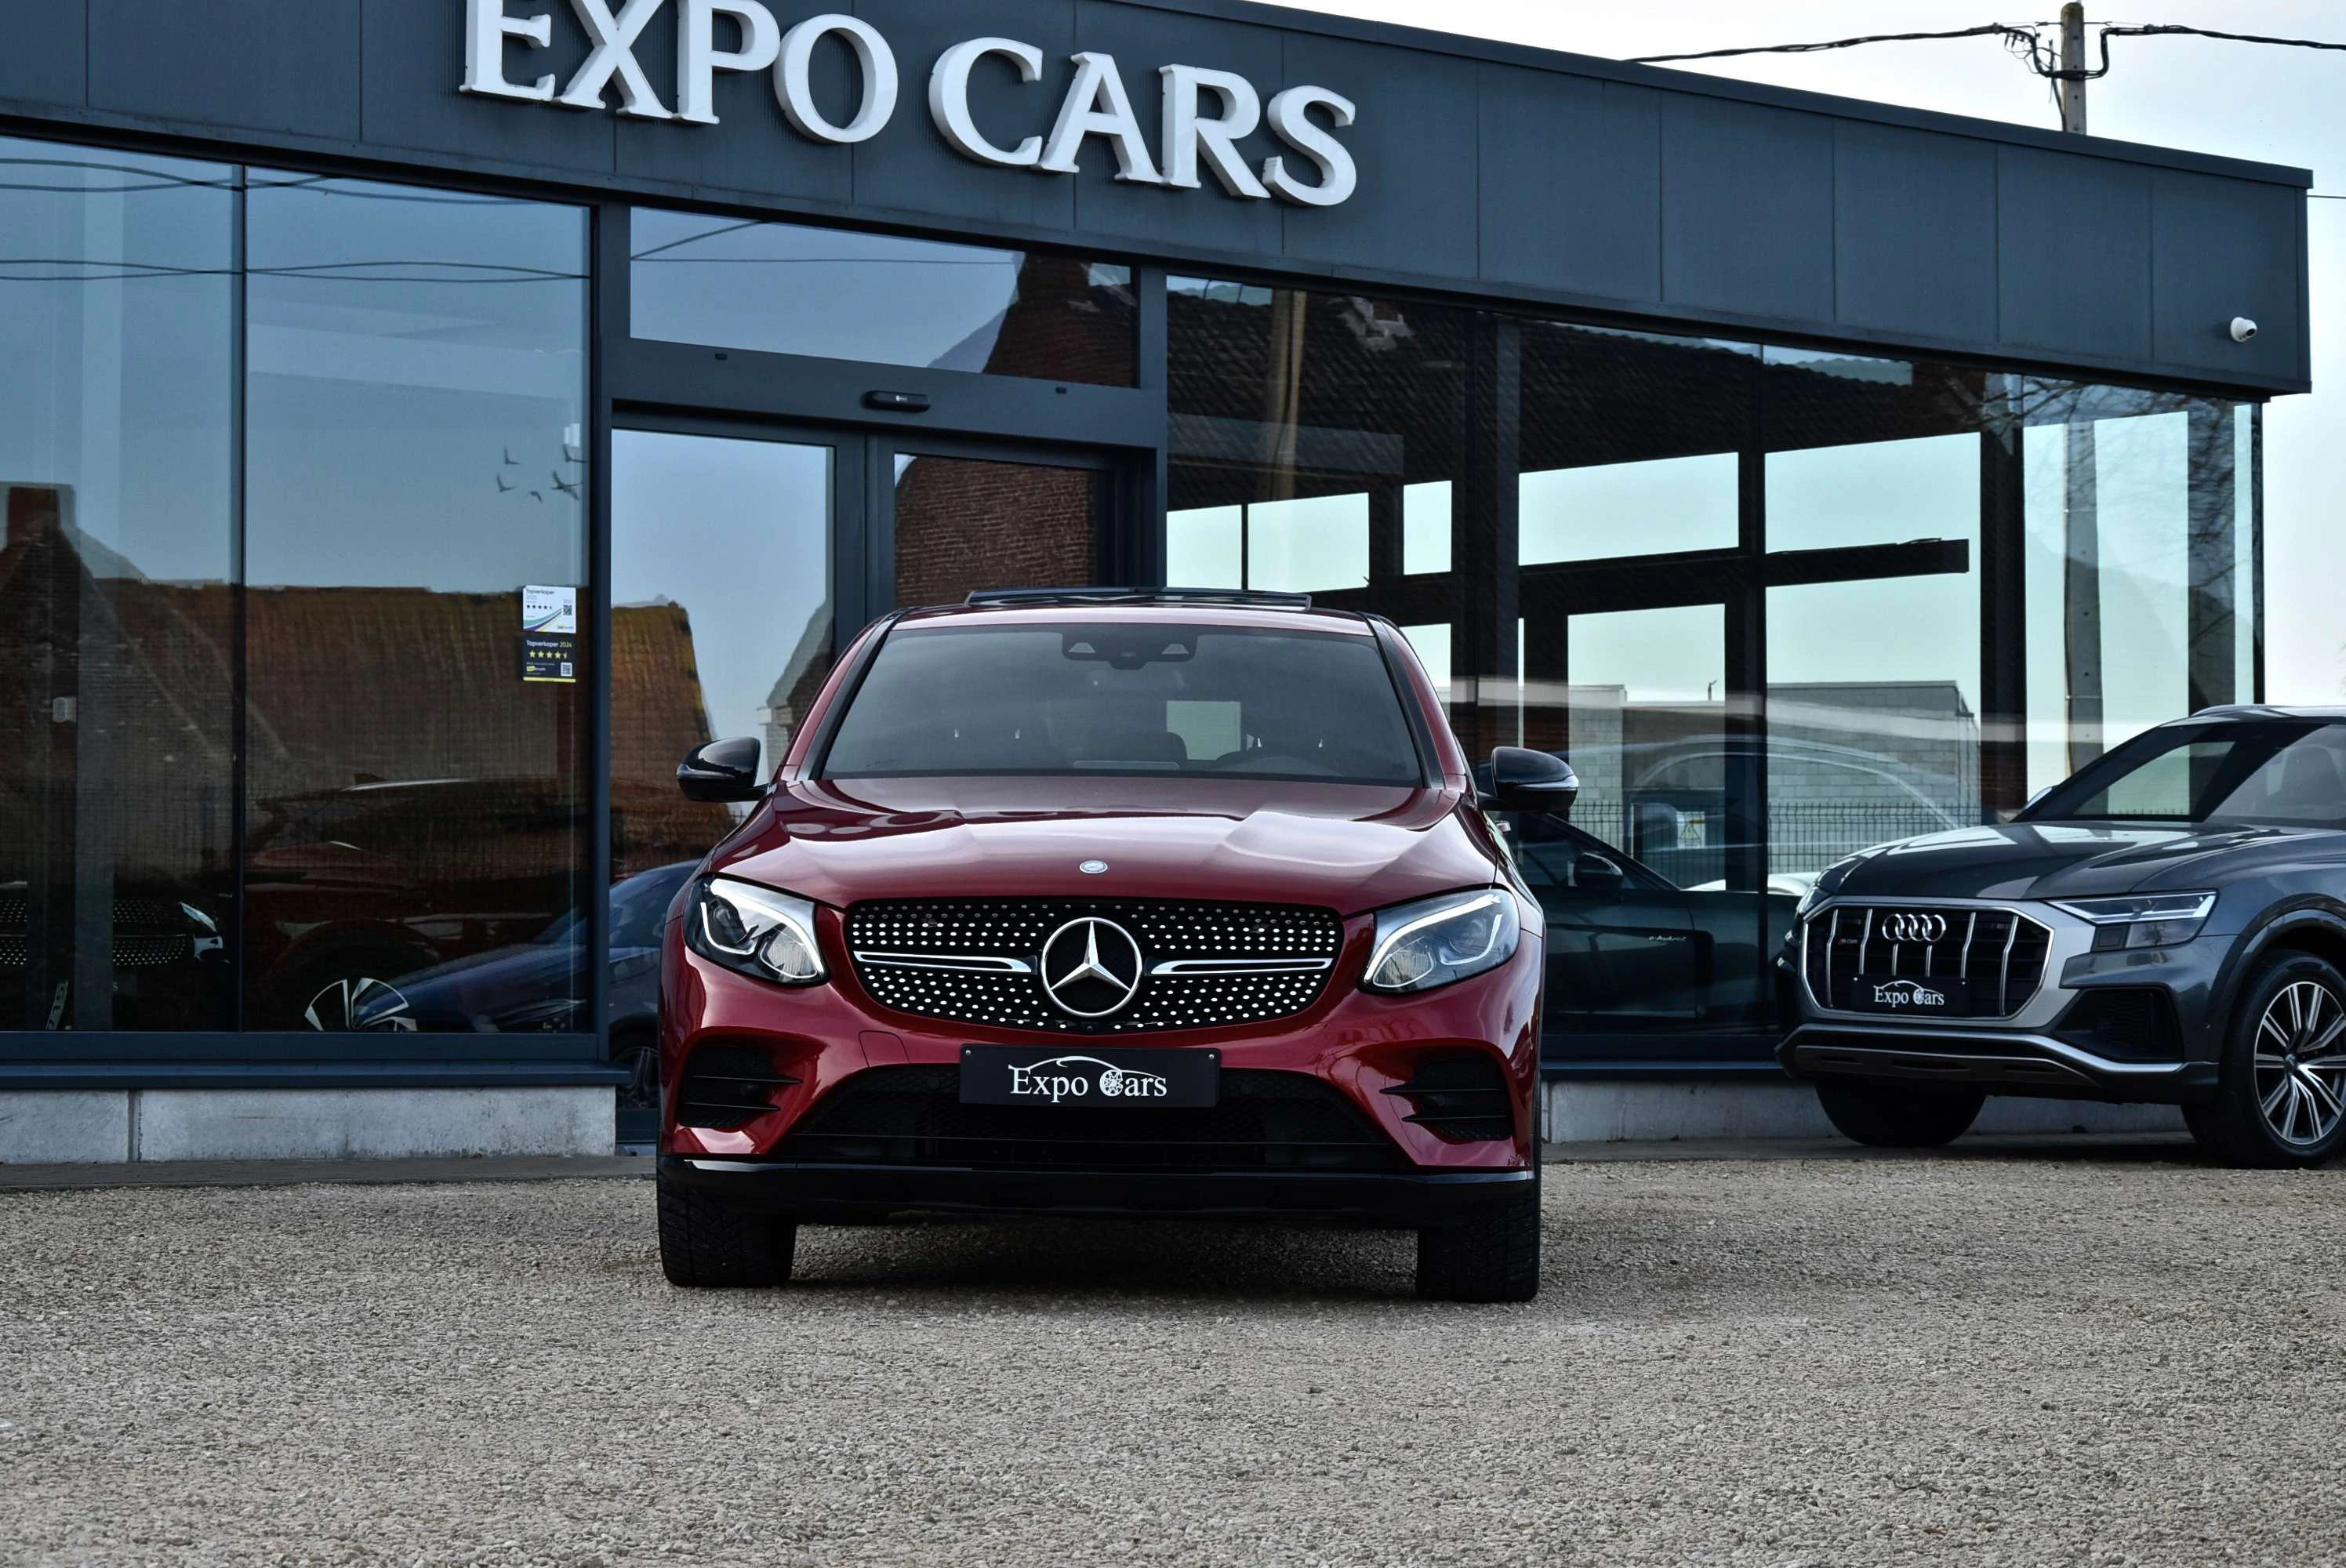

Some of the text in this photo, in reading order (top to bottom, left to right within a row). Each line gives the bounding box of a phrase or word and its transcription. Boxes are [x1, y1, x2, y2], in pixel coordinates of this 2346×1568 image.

[458, 0, 1358, 208] EXPO CARS
[1873, 985, 1945, 1007] Expo Cars
[1008, 1065, 1168, 1103] Expo Cars
